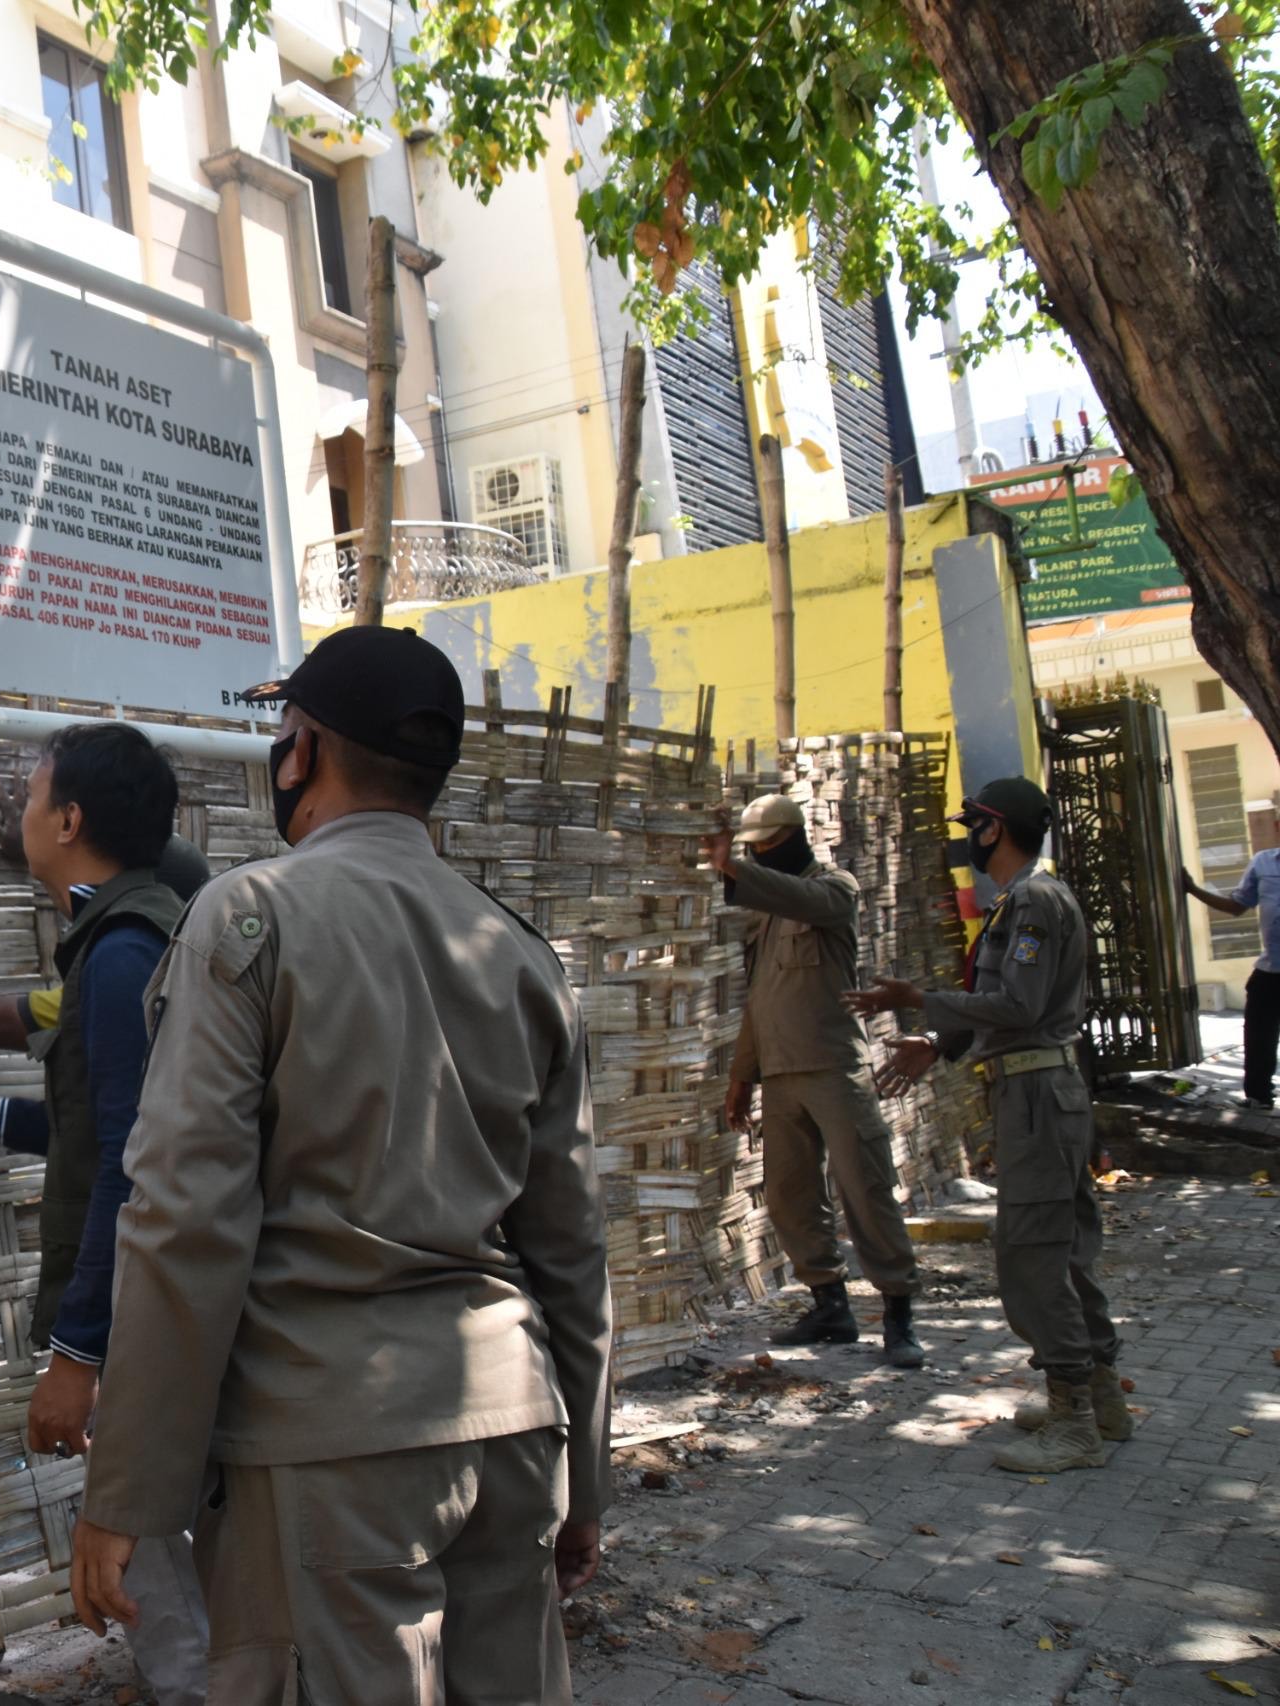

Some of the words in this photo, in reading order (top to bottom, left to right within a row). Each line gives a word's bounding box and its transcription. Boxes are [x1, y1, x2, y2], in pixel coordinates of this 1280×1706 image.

[51, 350, 120, 390] TANAH
[126, 377, 172, 408] ASET
[105, 408, 156, 438] KOTA
[162, 420, 254, 467] SURABAYA
[8, 452, 36, 470] DARI
[44, 461, 117, 492] PEMERINTAH
[123, 484, 152, 501] KOTA
[157, 492, 210, 516] SURABAYA
[216, 508, 259, 528] DIANCAM
[36, 441, 91, 466] MEMAKAI
[101, 459, 123, 475] DAN
[142, 471, 169, 488] ATAU
[177, 480, 258, 512] MEMANFAATKAN
[11, 491, 53, 512] TAHUN
[57, 503, 85, 519] 1960
[92, 510, 143, 533] TENTANG
[147, 525, 202, 548] LARANGAN
[206, 539, 262, 562] PEMAKAIAN
[44, 480, 93, 503] DENGAN
[102, 495, 136, 514] PASAL
[144, 507, 151, 518] 6
[159, 510, 202, 531] UNDANG
[220, 525, 261, 545] UNDANG
[1040, 500, 1117, 519] RESIENCES
[1088, 523, 1147, 540] REGENCY
[24, 513, 48, 531] IJIN
[52, 519, 84, 538] YANG
[88, 528, 134, 550] BERHAK
[137, 540, 164, 556] ATAU
[167, 547, 222, 570] KUASANYA
[1080, 555, 1114, 568] PARK
[28, 570, 40, 583] DI
[48, 573, 82, 591] PAKAI
[90, 581, 118, 598] ATAU
[125, 589, 216, 617] MENGHILANGKAN
[221, 608, 269, 627] SEBAGIAN
[31, 550, 139, 587] MENGHANCURKAN,
[143, 574, 217, 603] MERUSAKKAN,
[219, 590, 267, 611] MEMBIKIN
[1028, 588, 1078, 603] NATURA
[38, 610, 59, 624] 406
[62, 614, 95, 631] KUHP
[99, 621, 111, 634] Jo
[115, 626, 148, 641] PASAL
[152, 631, 169, 644] 170
[173, 636, 201, 649] KUHP
[41, 591, 78, 611] PAPAN
[85, 600, 117, 617] NAMA
[123, 606, 137, 620] INI
[143, 611, 190, 629] DIANCAM
[196, 622, 232, 637] PIDANA
[237, 628, 270, 645] SESUAI
